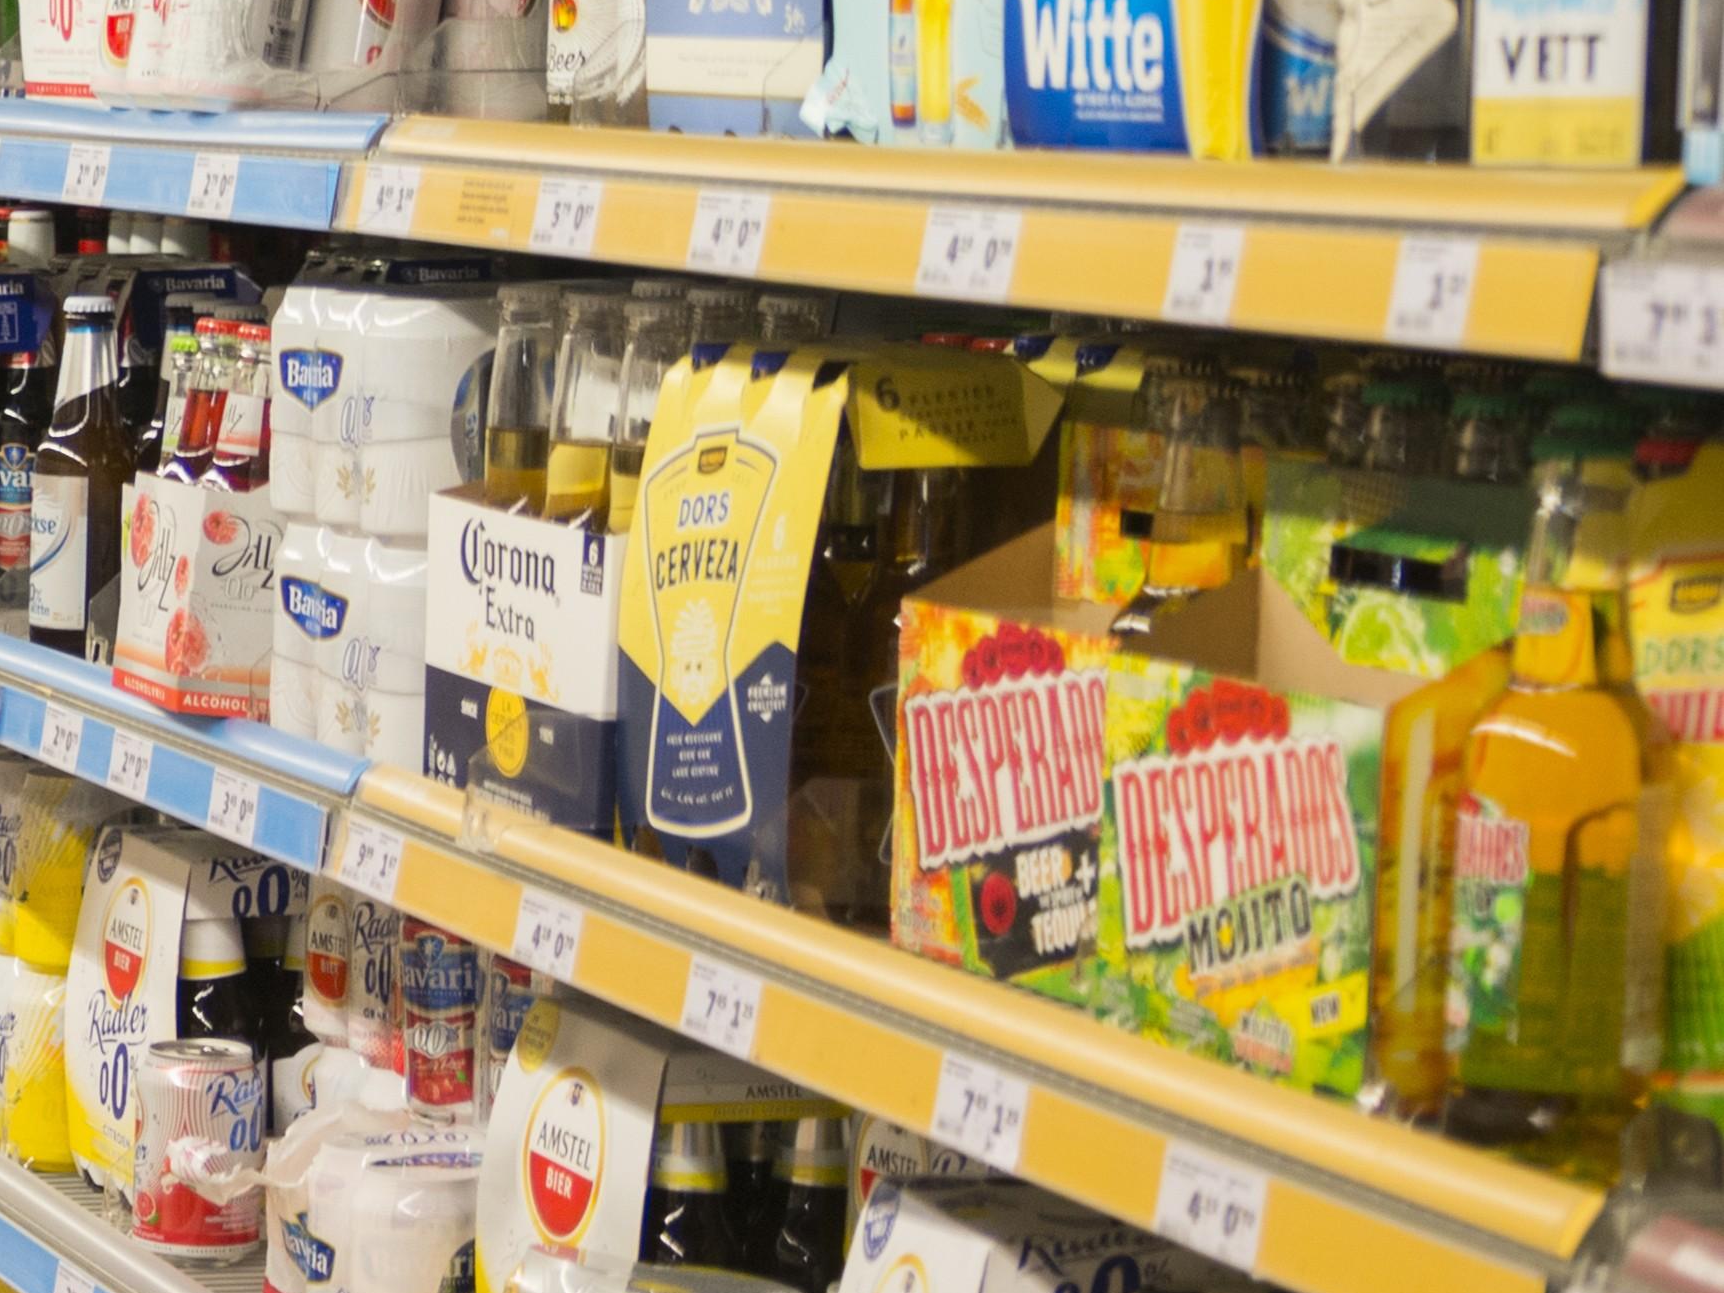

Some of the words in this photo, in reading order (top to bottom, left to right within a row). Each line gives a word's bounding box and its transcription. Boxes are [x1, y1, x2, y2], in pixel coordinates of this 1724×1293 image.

[166, 275, 226, 293] Bavaria
[678, 493, 728, 526] DORS
[460, 517, 556, 597] Corona
[654, 543, 739, 590] CERVEZA
[486, 598, 534, 643] Extra
[1121, 742, 1355, 936] DESPERADOS
[109, 916, 143, 950] AMSTEL
[1187, 887, 1312, 977] MOJITO
[113, 946, 130, 970] BIER
[89, 989, 147, 1054] Radler
[1310, 996, 1340, 1028] NEW
[537, 1122, 591, 1173] AMSTEL
[546, 1168, 573, 1199] BIER
